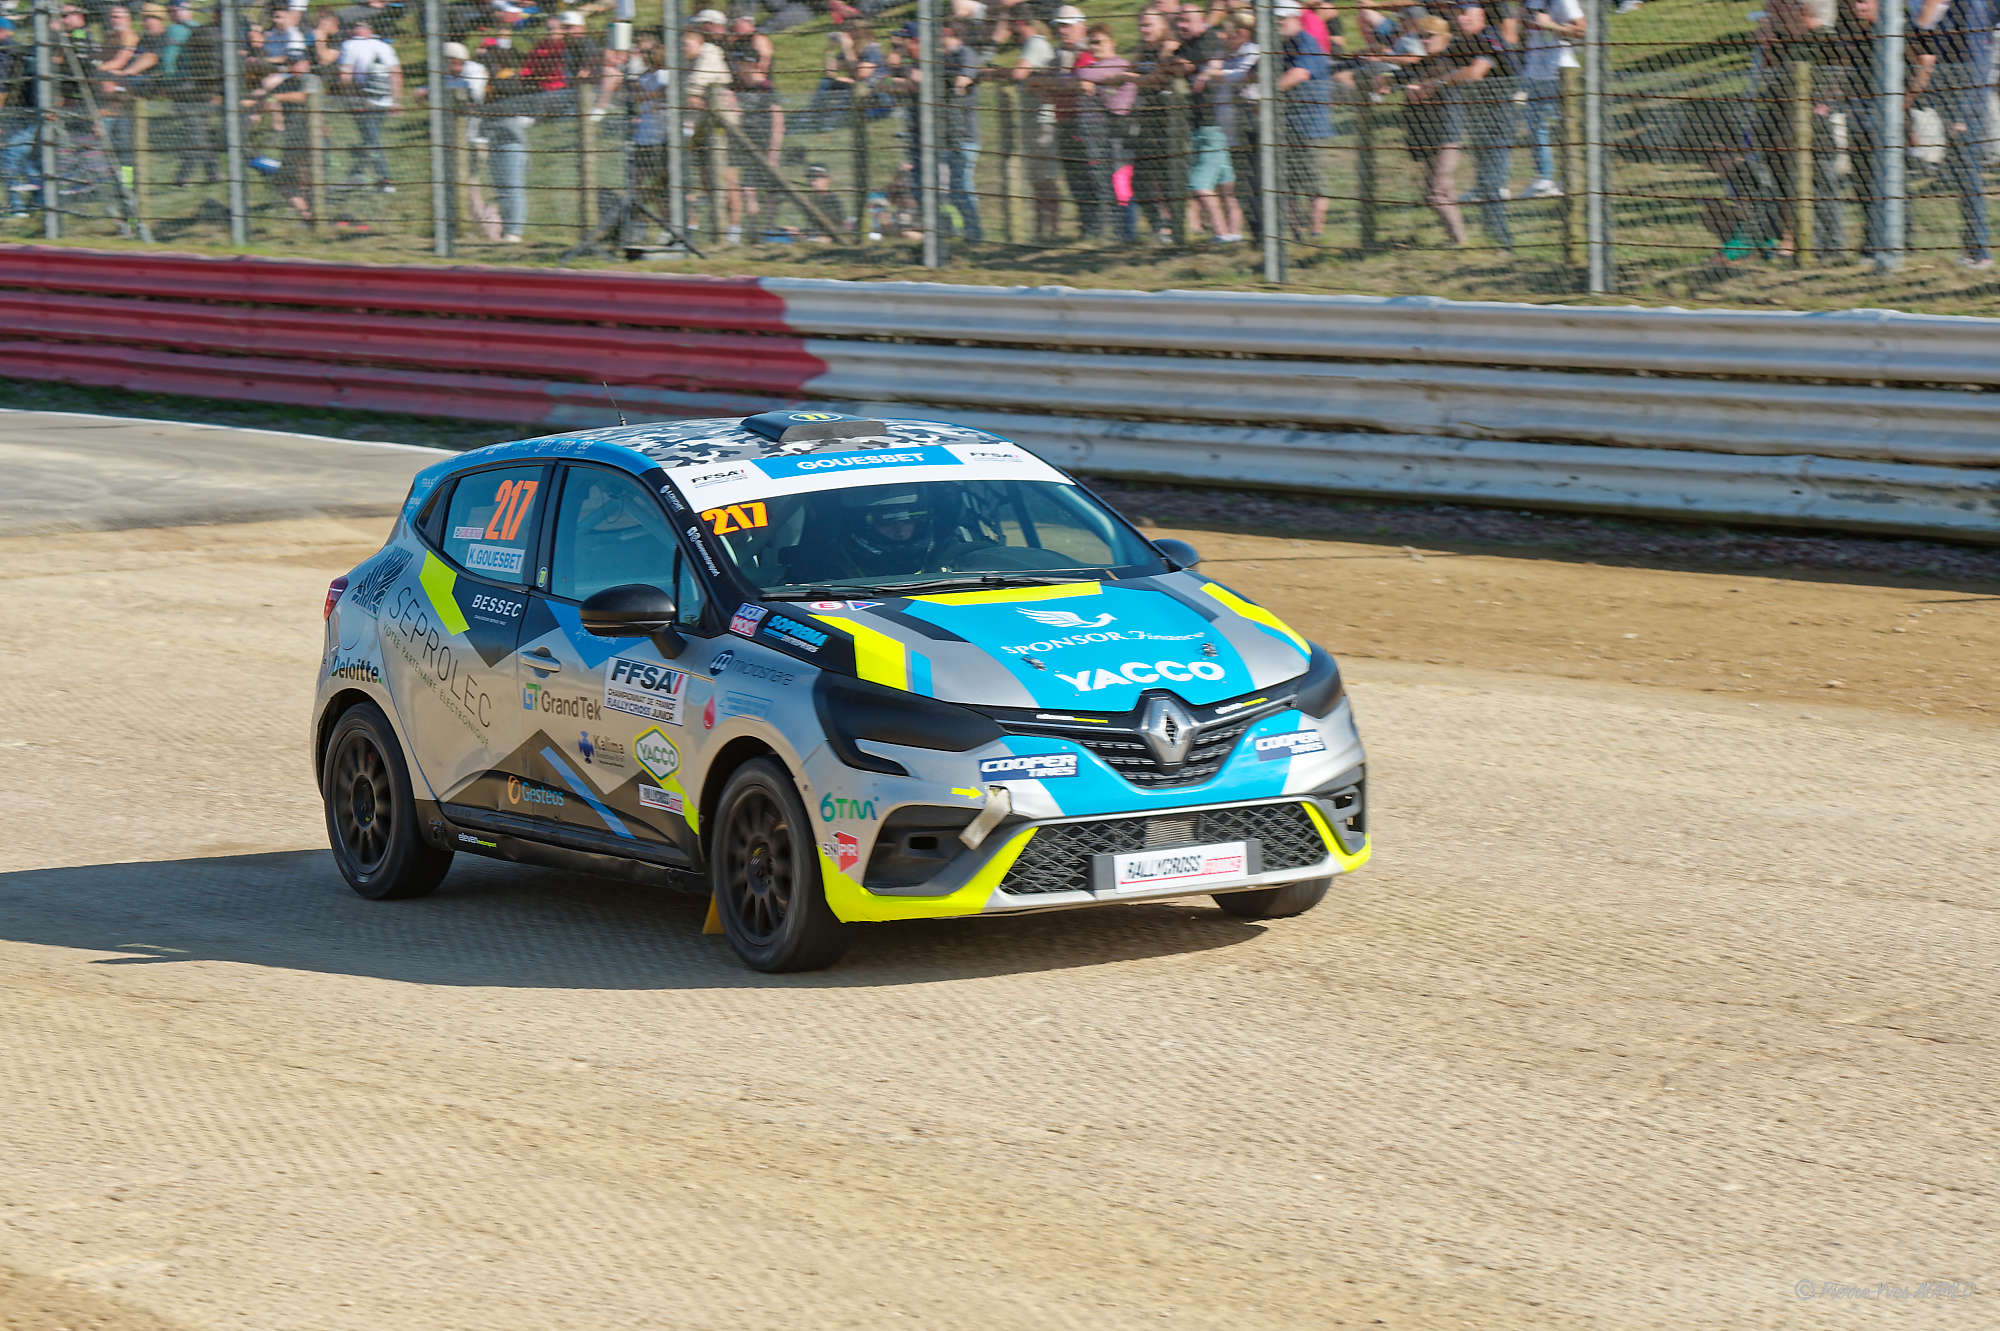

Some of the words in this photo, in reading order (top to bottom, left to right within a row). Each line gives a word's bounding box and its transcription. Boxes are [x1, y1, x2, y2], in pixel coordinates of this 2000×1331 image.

[796, 453, 924, 470] GOUESBET
[484, 479, 539, 540] 217
[701, 501, 768, 536] 217
[468, 547, 522, 571] K.GOUESBET
[471, 594, 522, 618] BESSEC
[767, 615, 829, 647] SOPREMA
[1001, 630, 1129, 655] SPONSOR
[388, 586, 493, 728] SEPROLEC
[1053, 660, 1226, 692] YACCO
[1256, 731, 1321, 751] COOPER
[639, 742, 677, 768] YACCO
[981, 754, 1077, 773] COOPER
[1026, 768, 1077, 778] TIRES
[521, 781, 565, 807] Gesteos
